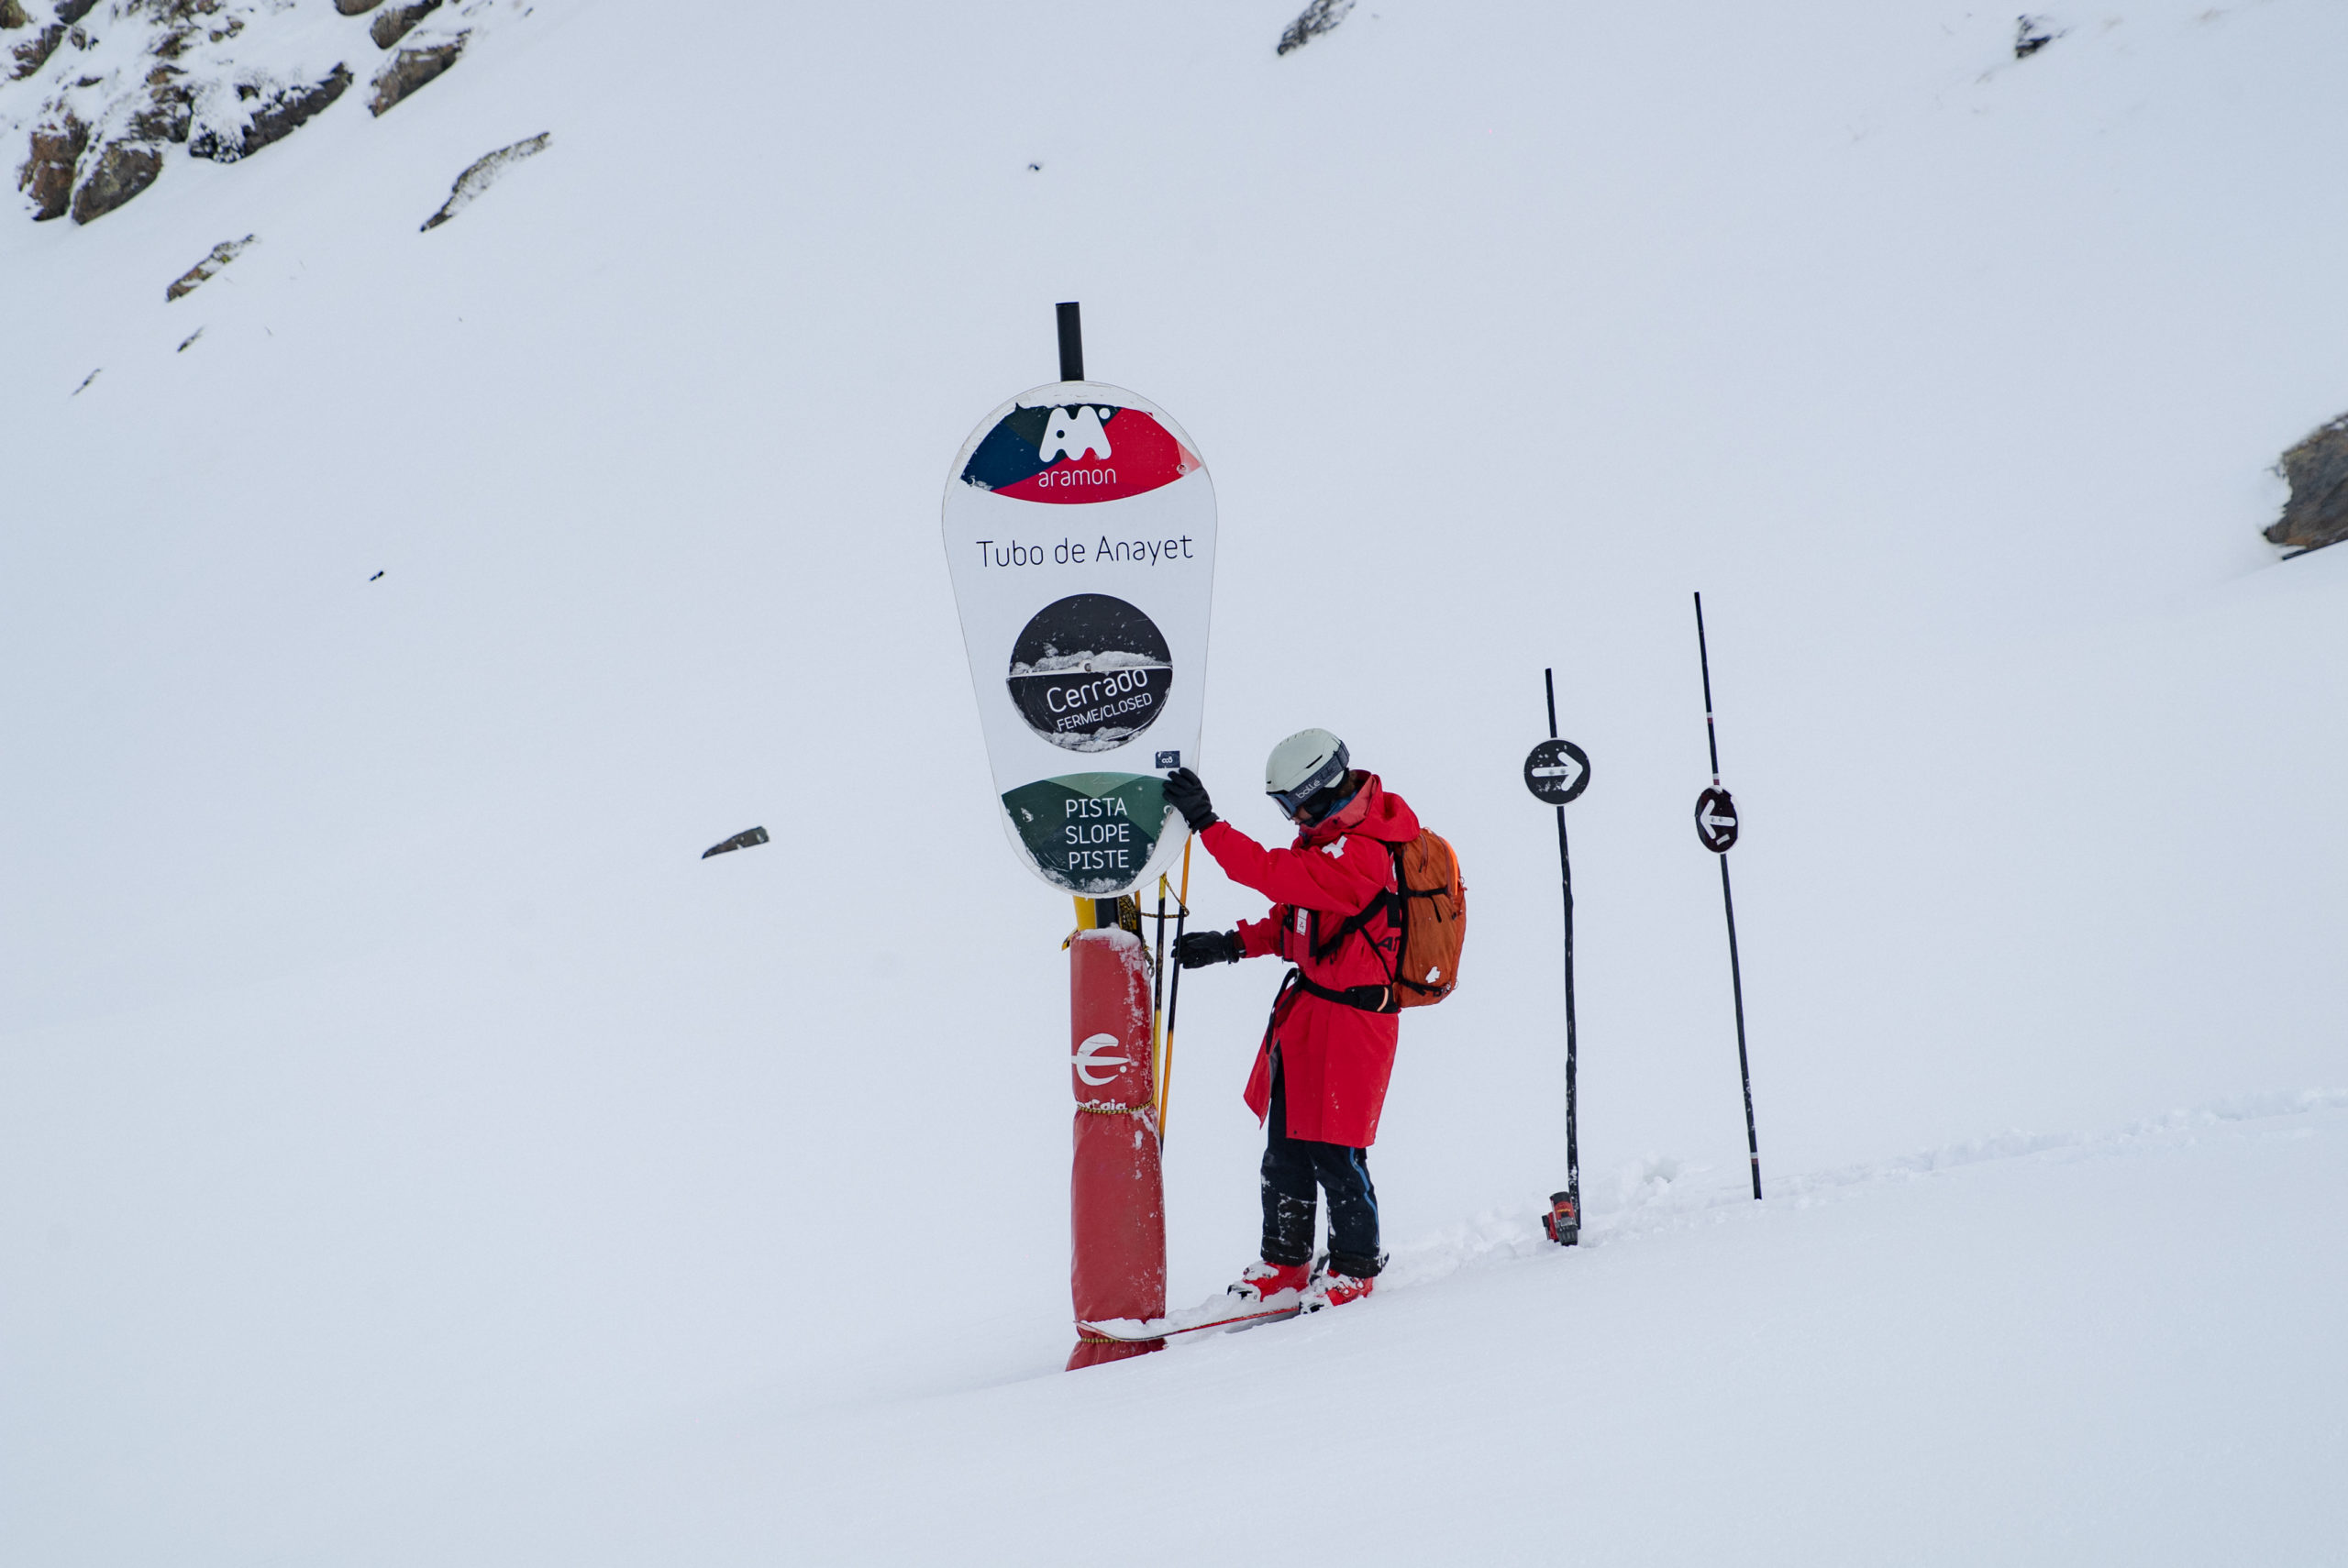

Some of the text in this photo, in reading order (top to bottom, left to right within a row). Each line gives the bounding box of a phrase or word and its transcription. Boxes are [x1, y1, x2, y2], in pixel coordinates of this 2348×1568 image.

[1038, 468, 1116, 488] aramon
[976, 535, 1194, 568] Tubo de Anayet
[1047, 669, 1148, 713] Cerrado
[1066, 797, 1128, 819] PISTA
[1065, 823, 1131, 845] SLOPE
[1069, 849, 1130, 870] PISTE
